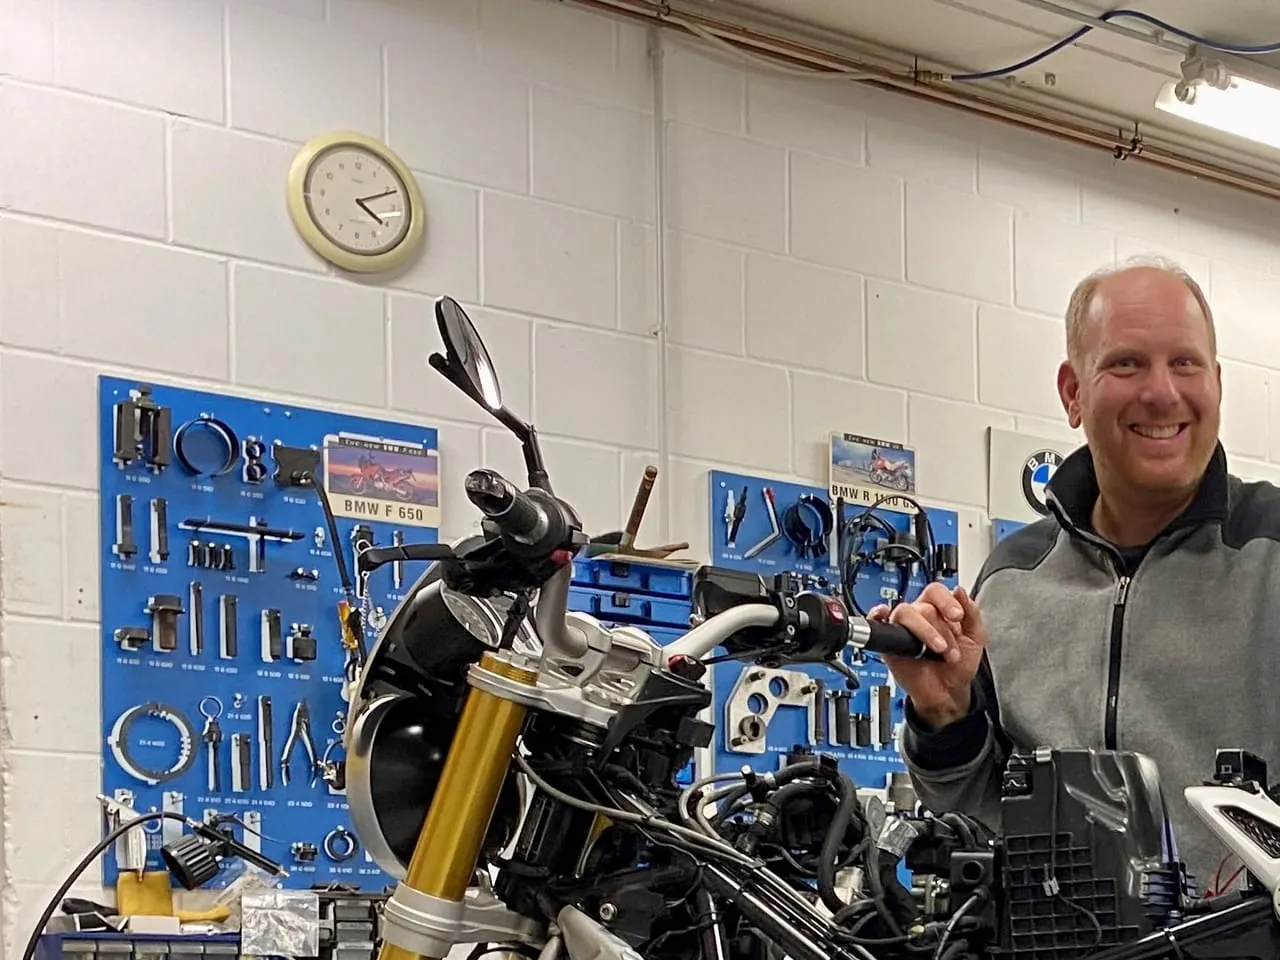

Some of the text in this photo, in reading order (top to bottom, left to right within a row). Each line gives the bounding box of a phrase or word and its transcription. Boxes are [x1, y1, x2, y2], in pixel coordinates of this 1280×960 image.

[1027, 452, 1056, 472] BM
[831, 485, 859, 499] BMW
[863, 490, 870, 501] R
[345, 500, 423, 521] BMW F 650
